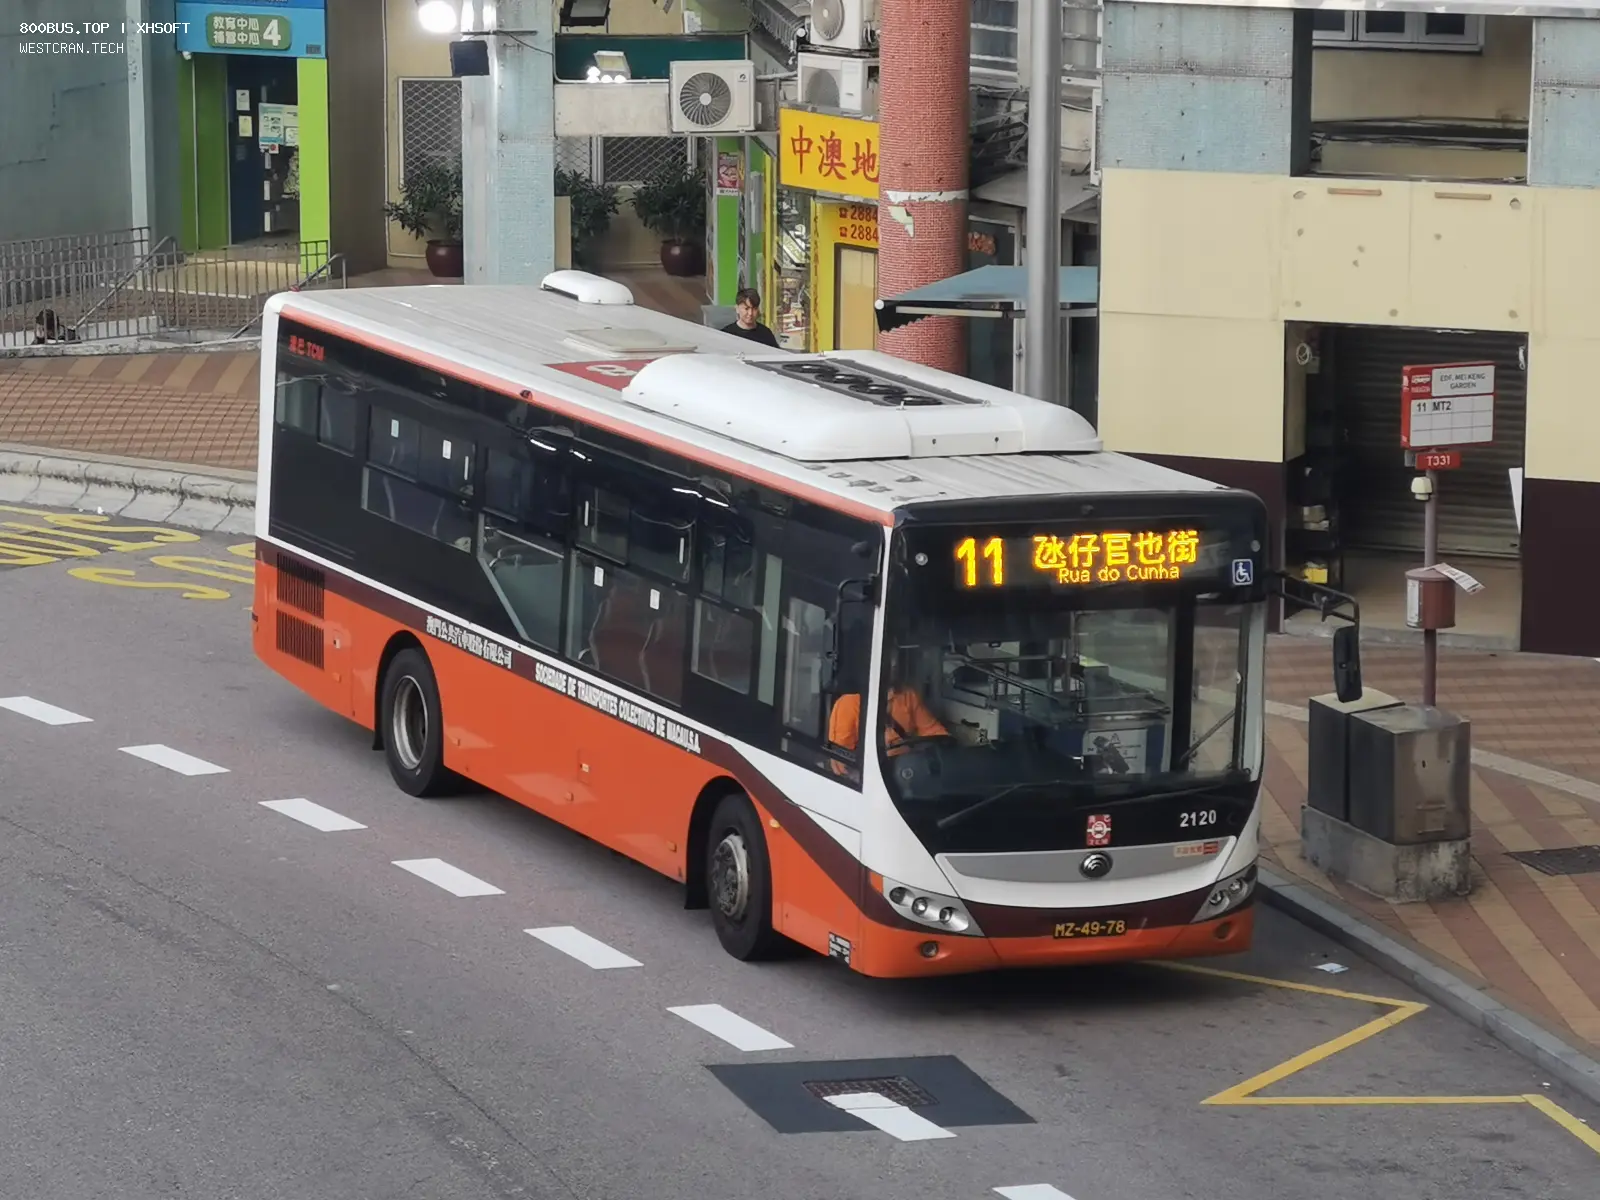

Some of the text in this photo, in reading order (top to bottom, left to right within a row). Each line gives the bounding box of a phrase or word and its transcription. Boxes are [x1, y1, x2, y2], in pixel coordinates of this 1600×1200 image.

[262, 19, 282, 46] 4
[791, 125, 879, 183] 中澳地
[850, 224, 879, 242] 2884
[1416, 401, 1452, 412] 11 MT2
[1426, 455, 1451, 466] T331
[956, 537, 1004, 587] 11
[1059, 564, 1180, 584] Rua do Cunha
[567, 675, 577, 697] DE
[577, 680, 618, 716] TRANSPORTES
[618, 699, 656, 733] COLECTIVOS
[656, 715, 666, 738] DE
[1179, 809, 1217, 828] 2120
[1054, 920, 1126, 937] MZ-49-78
